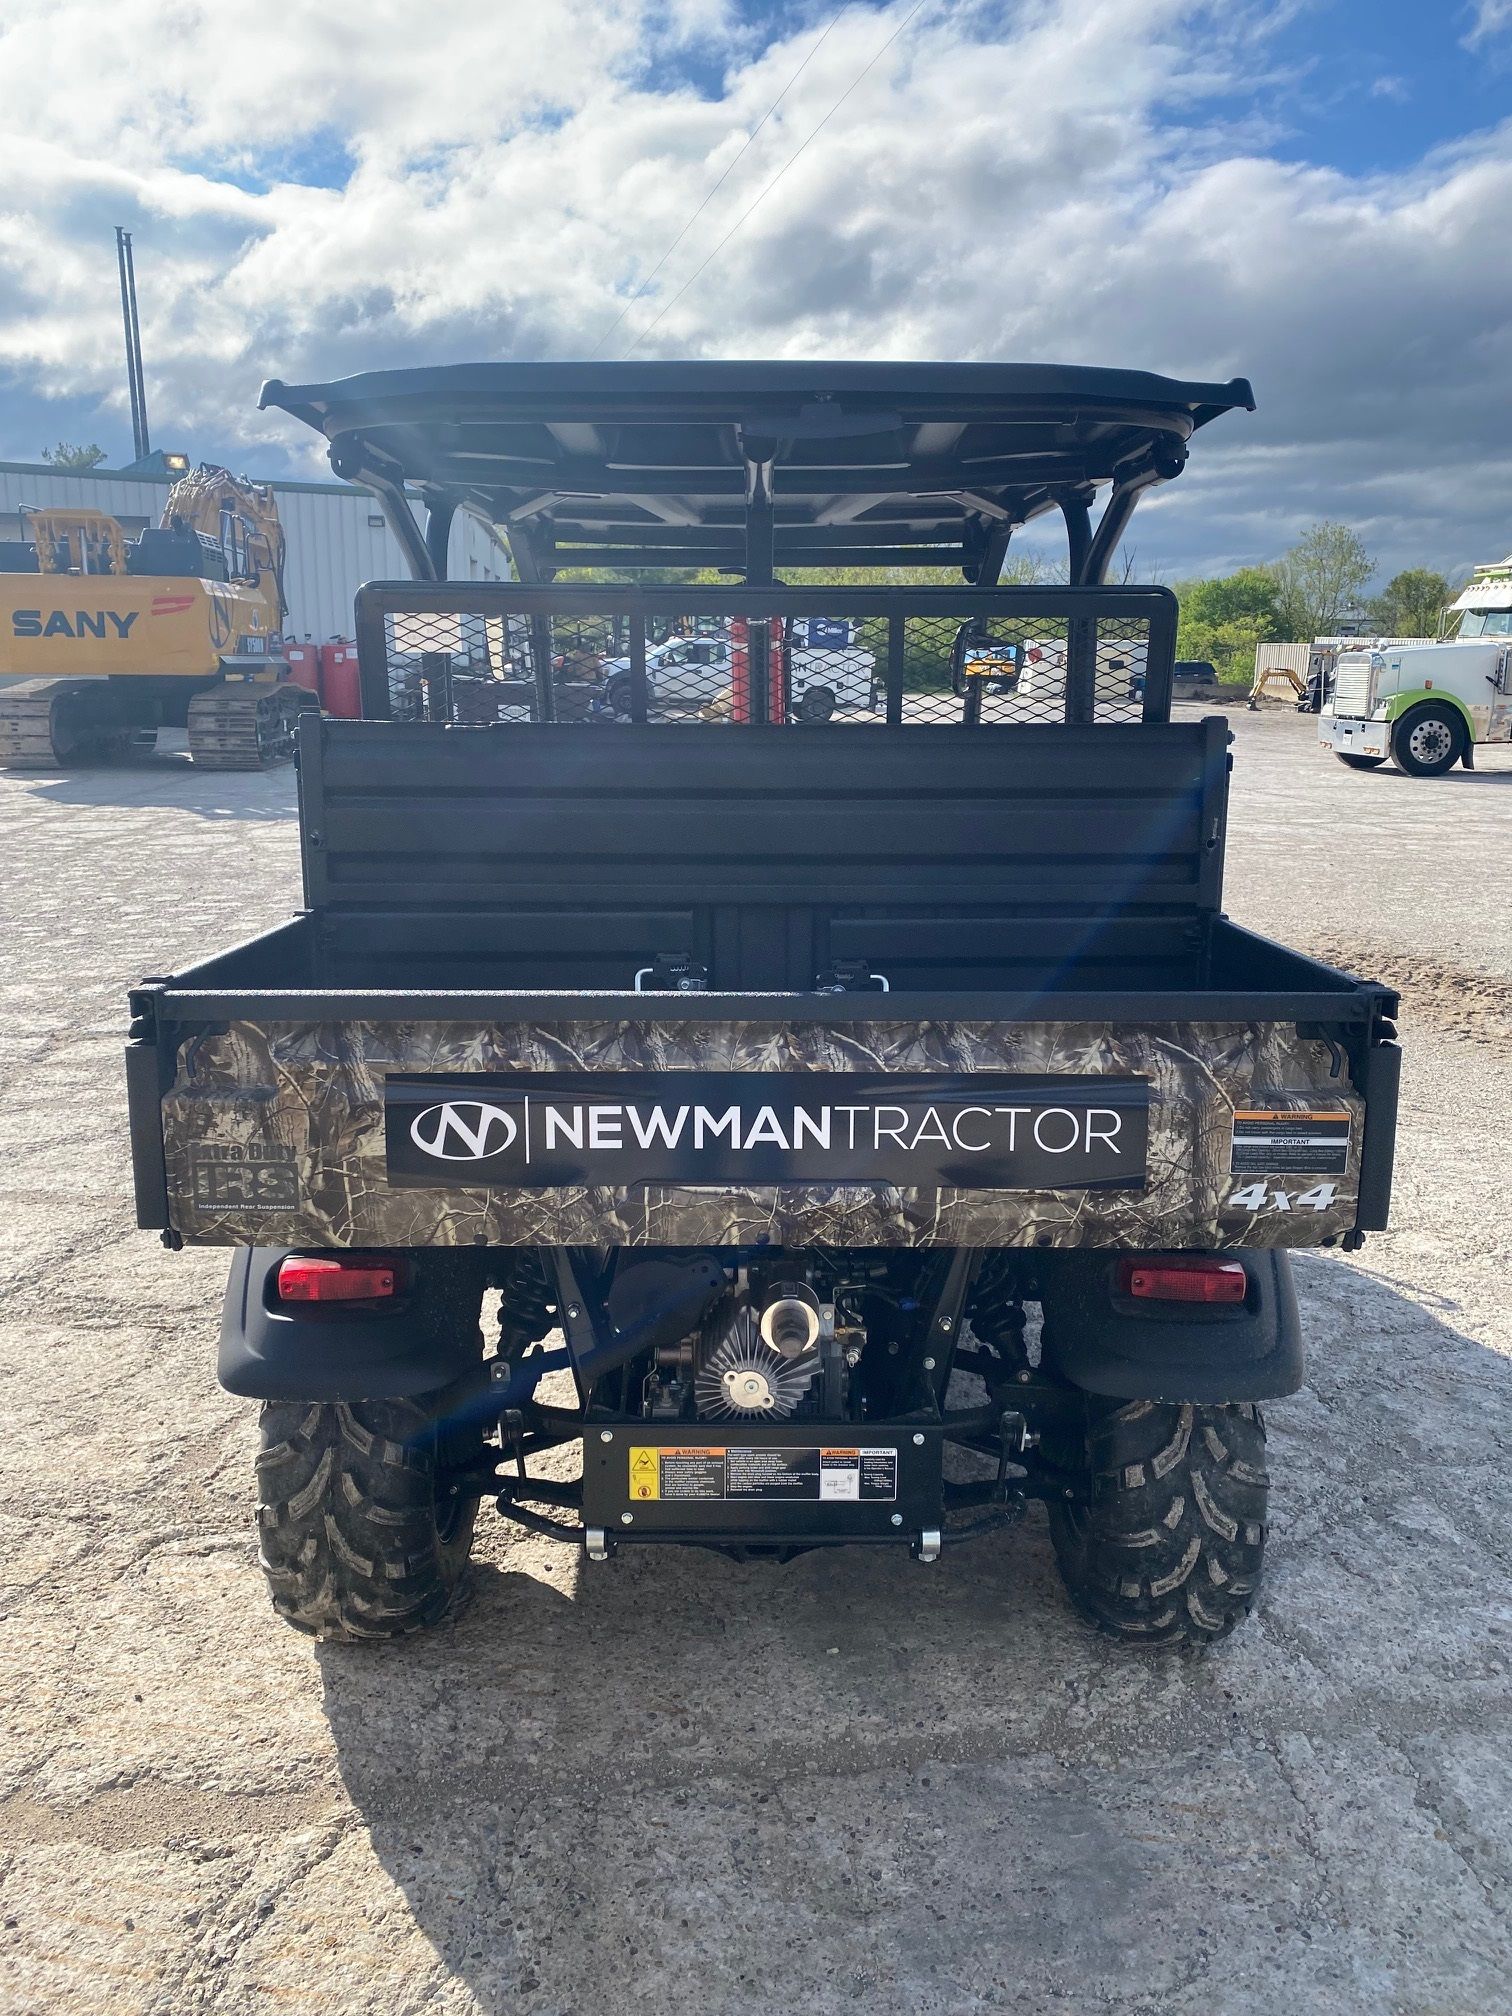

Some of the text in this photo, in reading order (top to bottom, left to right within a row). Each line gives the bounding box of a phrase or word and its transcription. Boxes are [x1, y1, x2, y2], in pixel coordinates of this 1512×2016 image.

[12, 610, 140, 639] SANY
[545, 1105, 1122, 1154] NEWMANTRACTOR
[1228, 1183, 1336, 1211] 4x4
